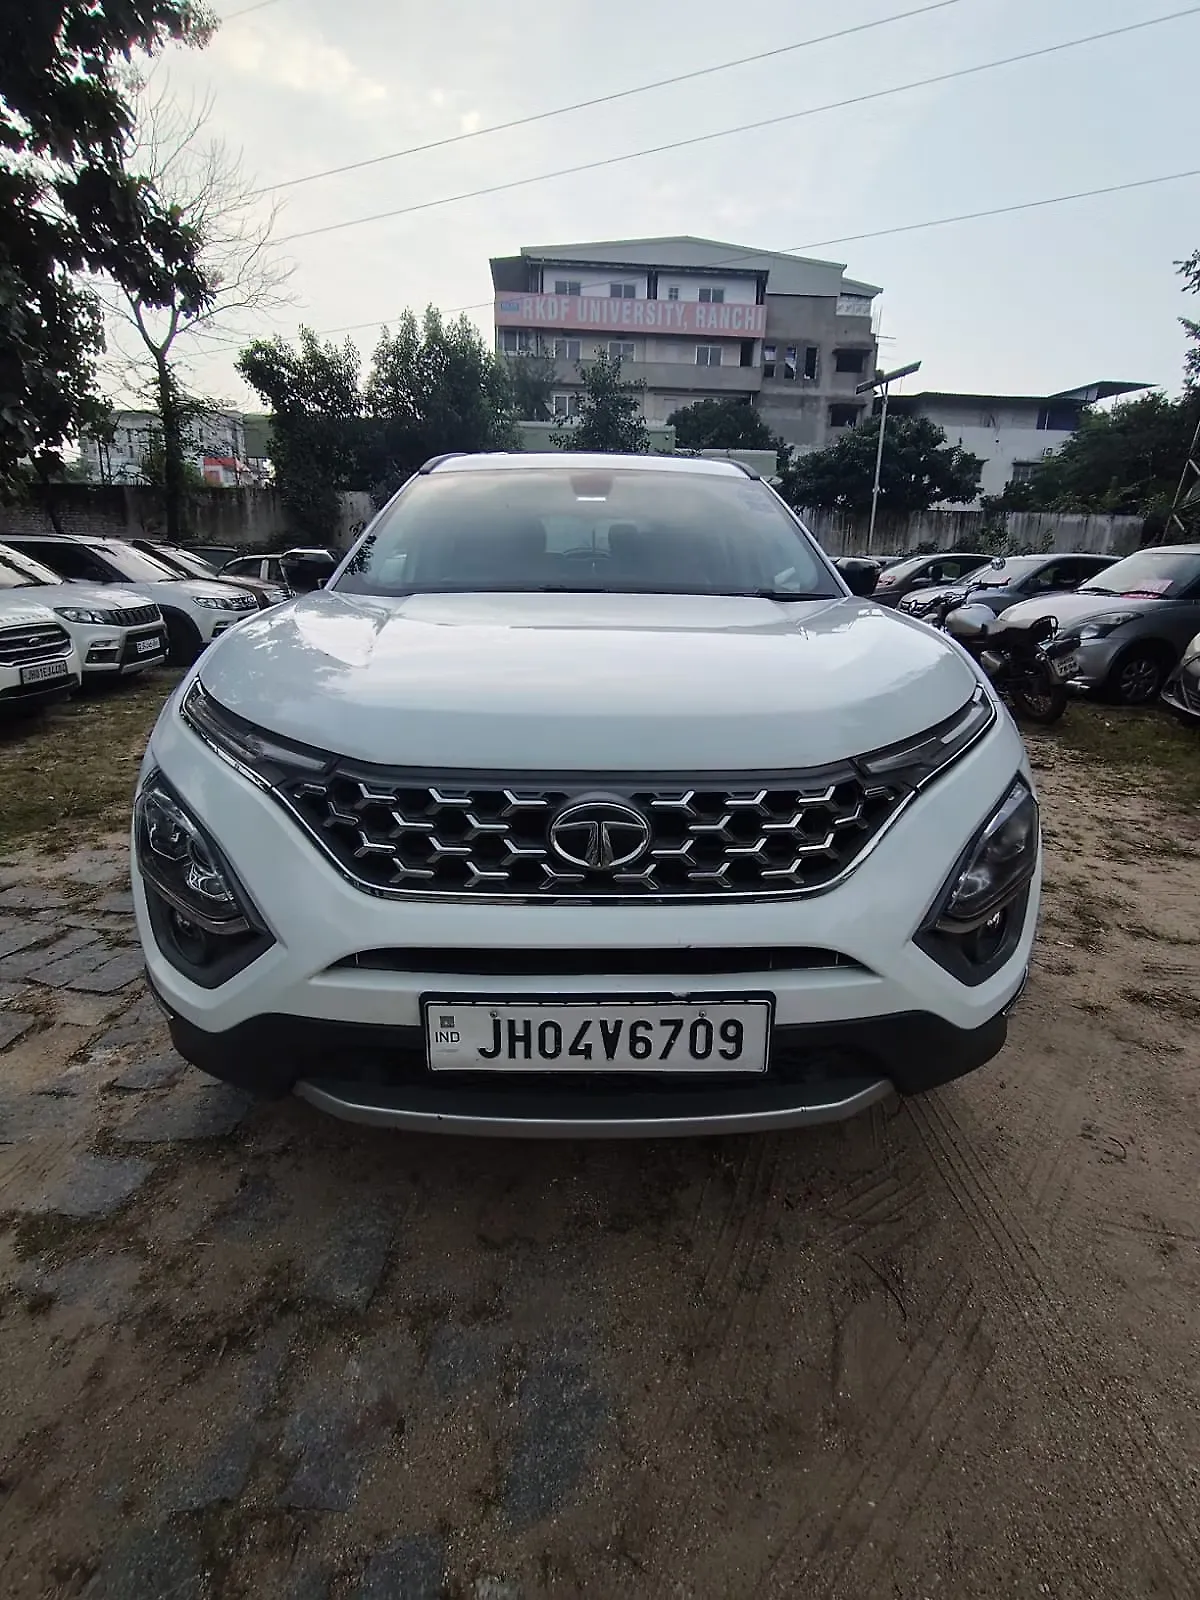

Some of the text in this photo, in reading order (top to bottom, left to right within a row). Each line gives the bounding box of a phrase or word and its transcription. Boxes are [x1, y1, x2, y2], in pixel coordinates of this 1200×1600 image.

[522, 297, 763, 331] RKDF UNIVERSITY, RANCHI
[435, 1031, 460, 1043] IND
[478, 1018, 744, 1061] JH04V6709
